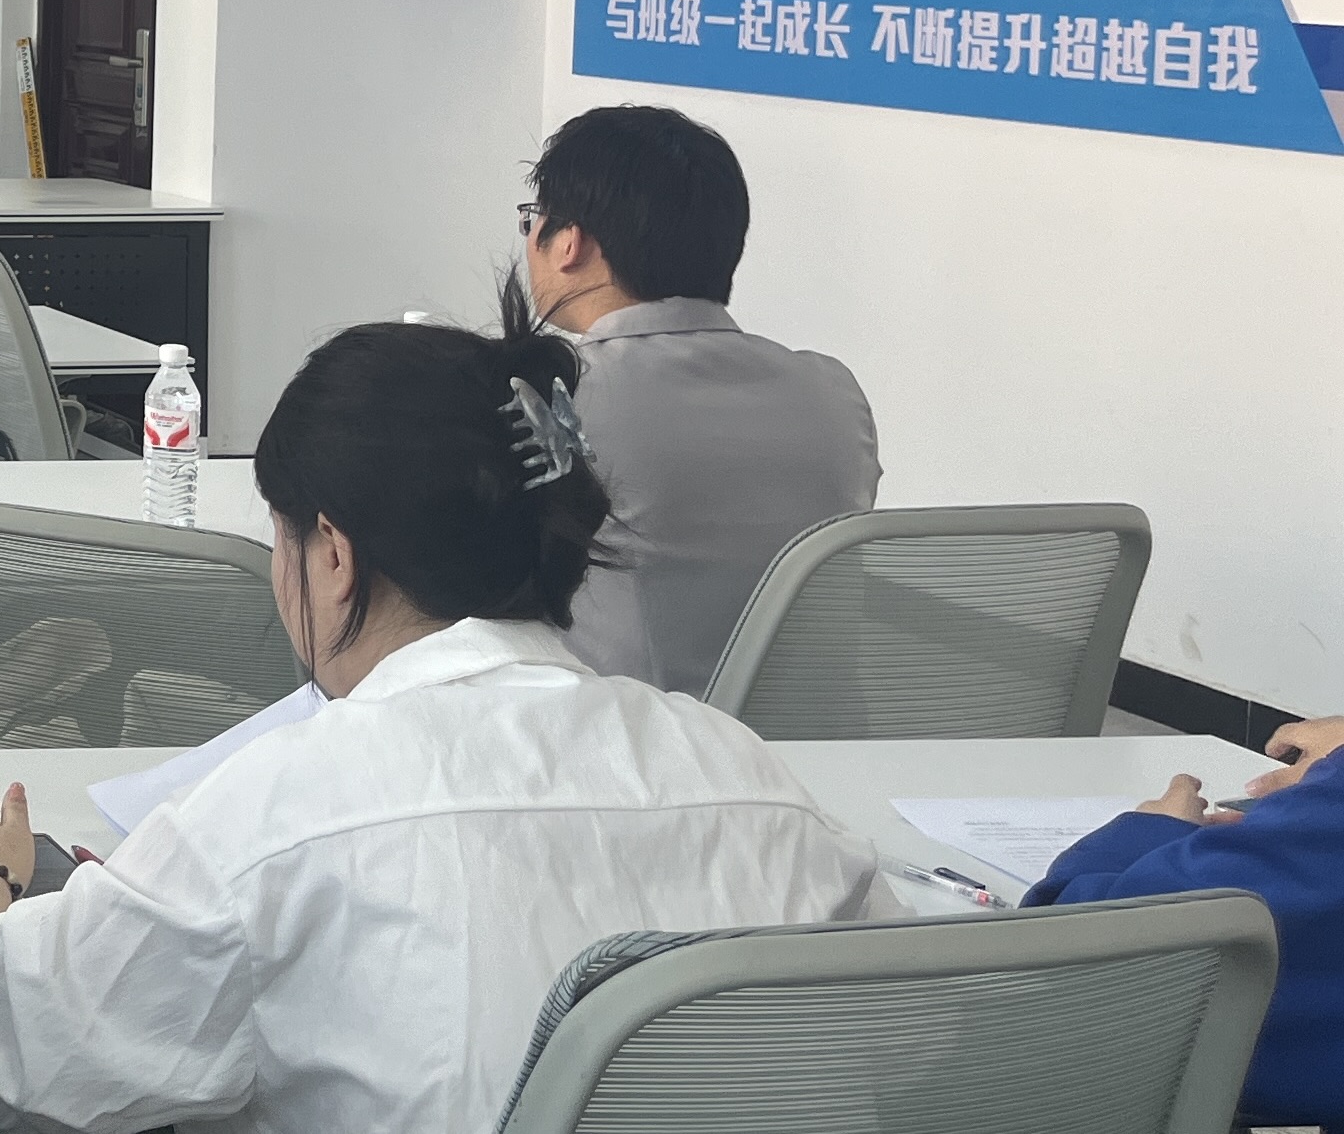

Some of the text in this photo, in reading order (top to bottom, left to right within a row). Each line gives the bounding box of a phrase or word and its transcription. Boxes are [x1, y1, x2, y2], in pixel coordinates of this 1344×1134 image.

[870, 3, 1259, 95] 不断提升超越自我
